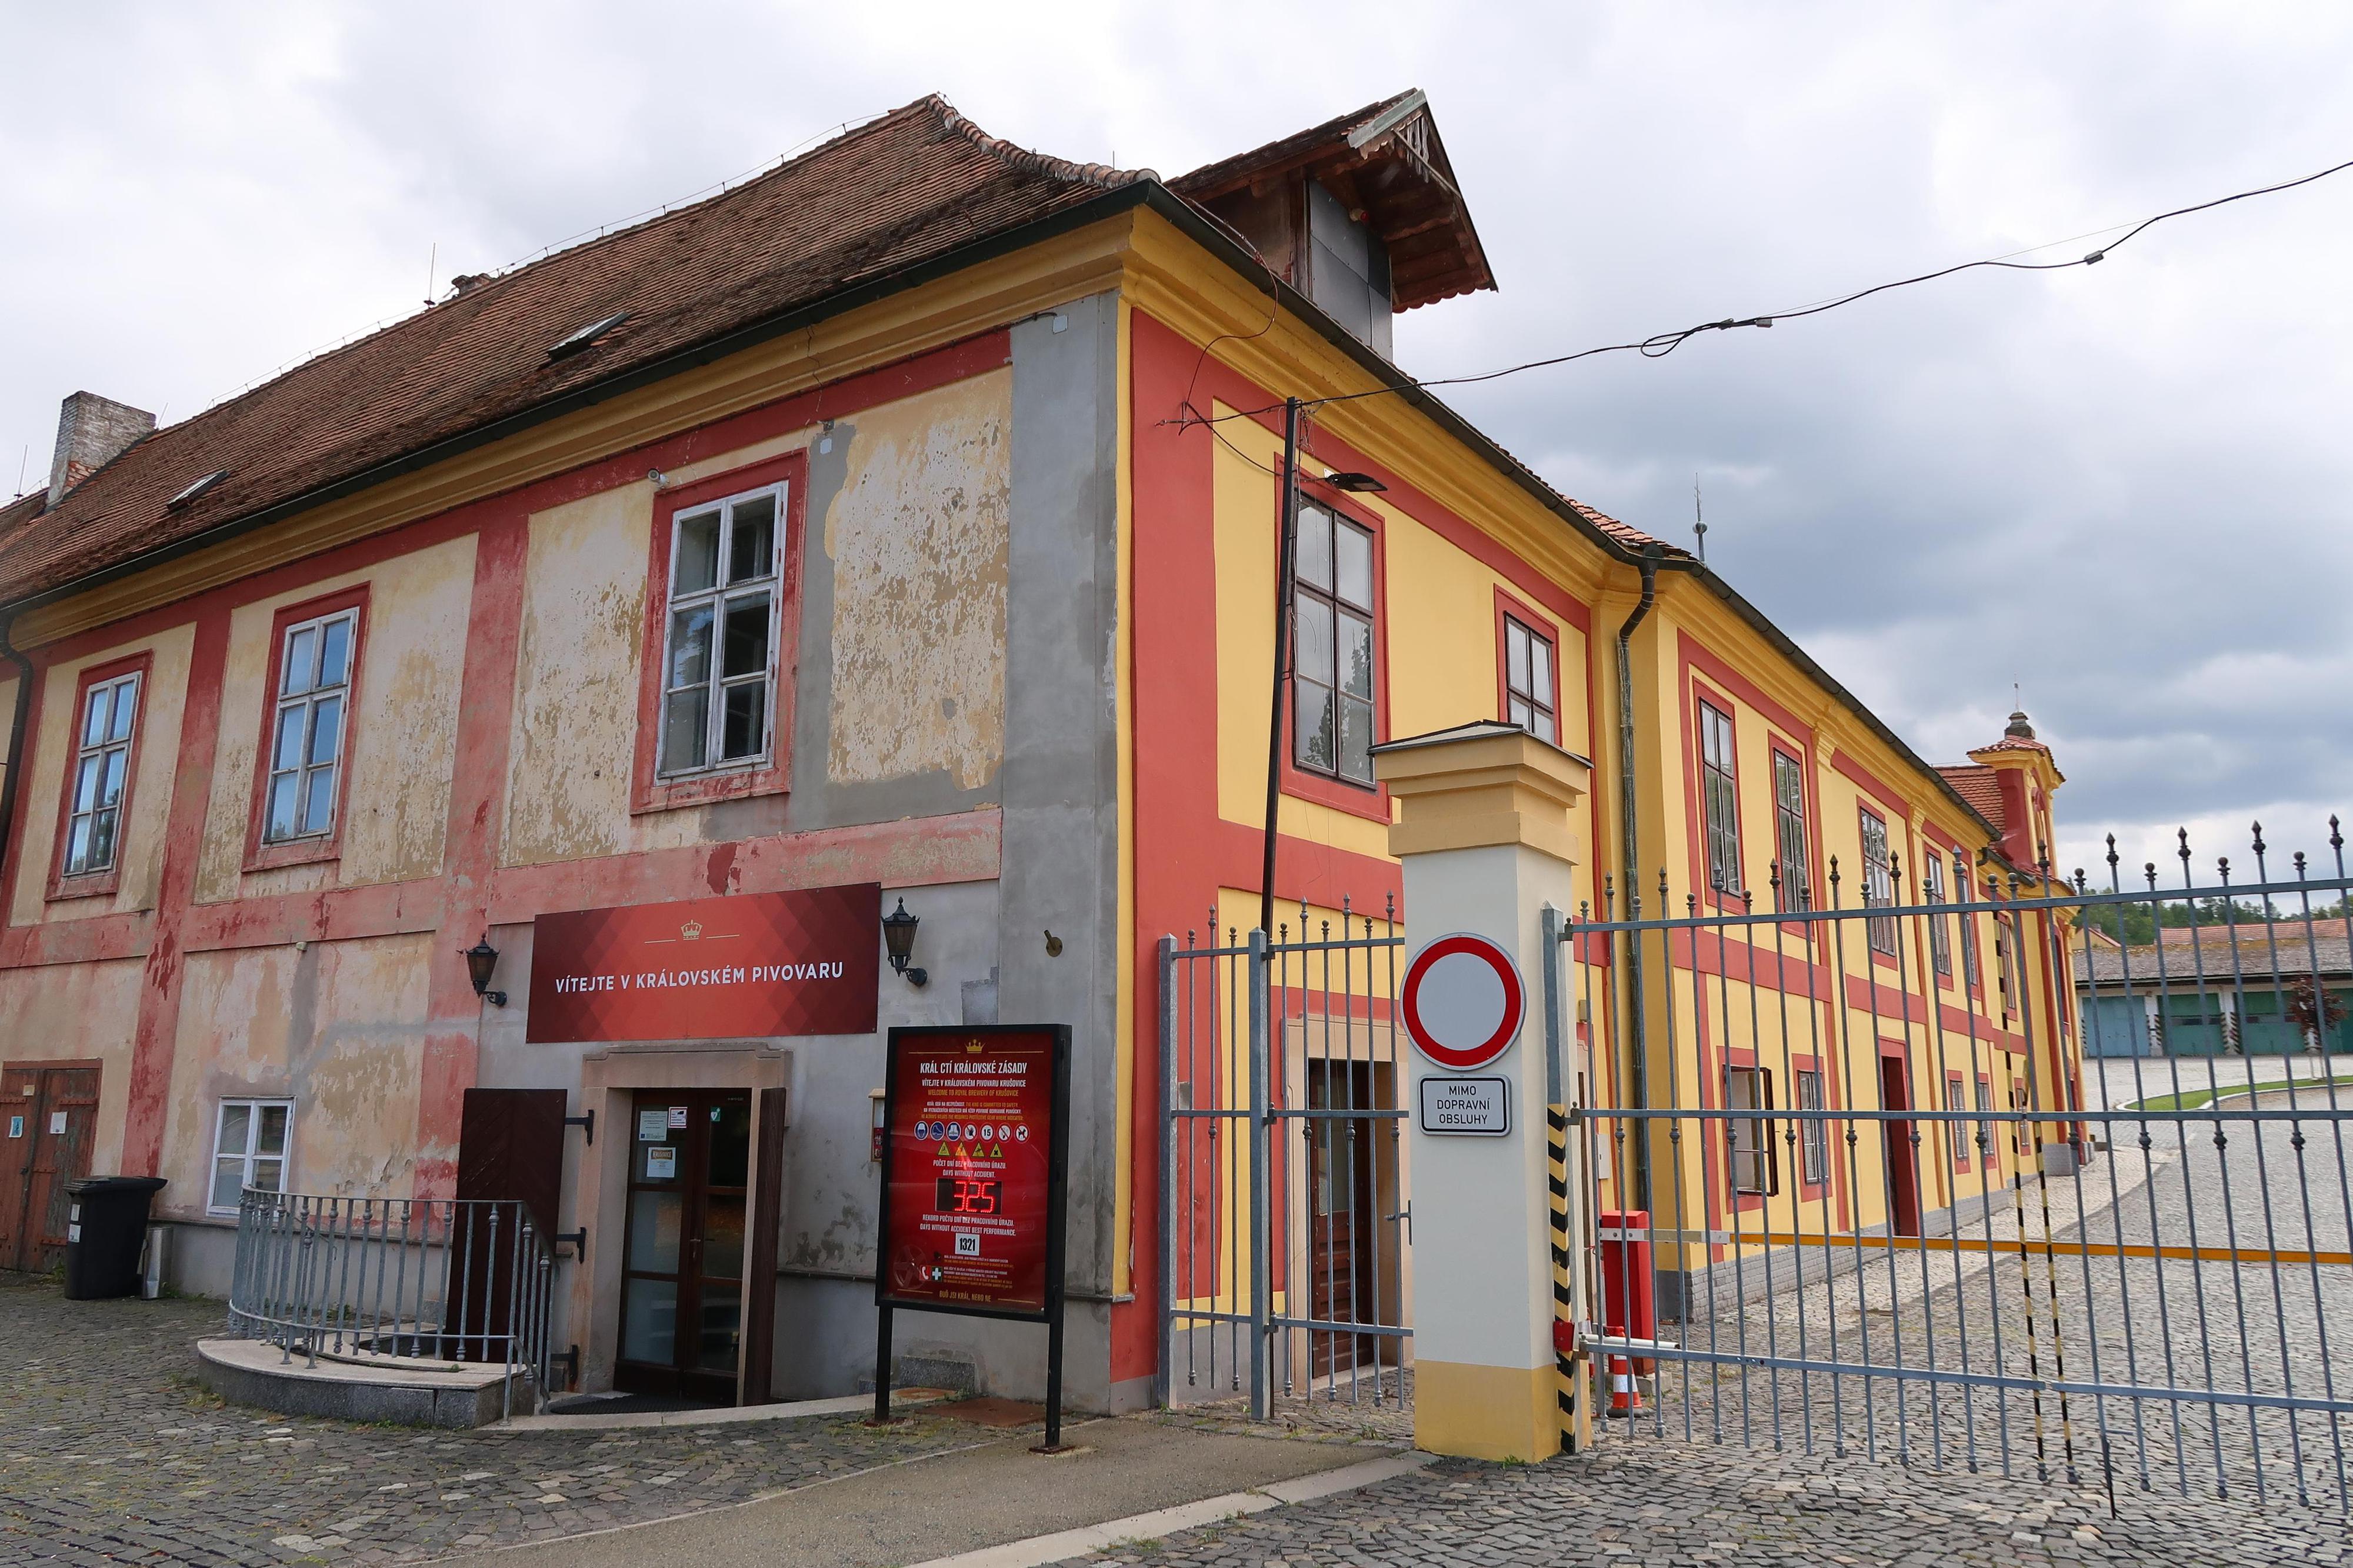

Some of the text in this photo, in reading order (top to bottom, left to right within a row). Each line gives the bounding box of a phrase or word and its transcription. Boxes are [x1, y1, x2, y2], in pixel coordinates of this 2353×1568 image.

[555, 962, 844, 993] VÍTEJTE V KRÁLOVSKÉM PIVOVARU
[920, 1060, 1027, 1073] KRÁL CTÍ KRÁLOVSKÉ ZÁSADY
[922, 1077, 939, 1086] VÍTEJTE
[945, 1077, 975, 1087] KRÁLOVSKÉM
[1000, 1078, 1026, 1087] KRUŠOVICE
[995, 1088, 1019, 1096] KRUŠOVICE
[1449, 1086, 1477, 1095] MIMO
[1437, 1097, 1491, 1110] DOPRAVNÍ
[1439, 1113, 1488, 1125] OBSLUHY
[954, 1181, 995, 1213] 325
[971, 1217, 998, 1225] PRACOVNÍHO
[959, 1237, 975, 1252] 1321
